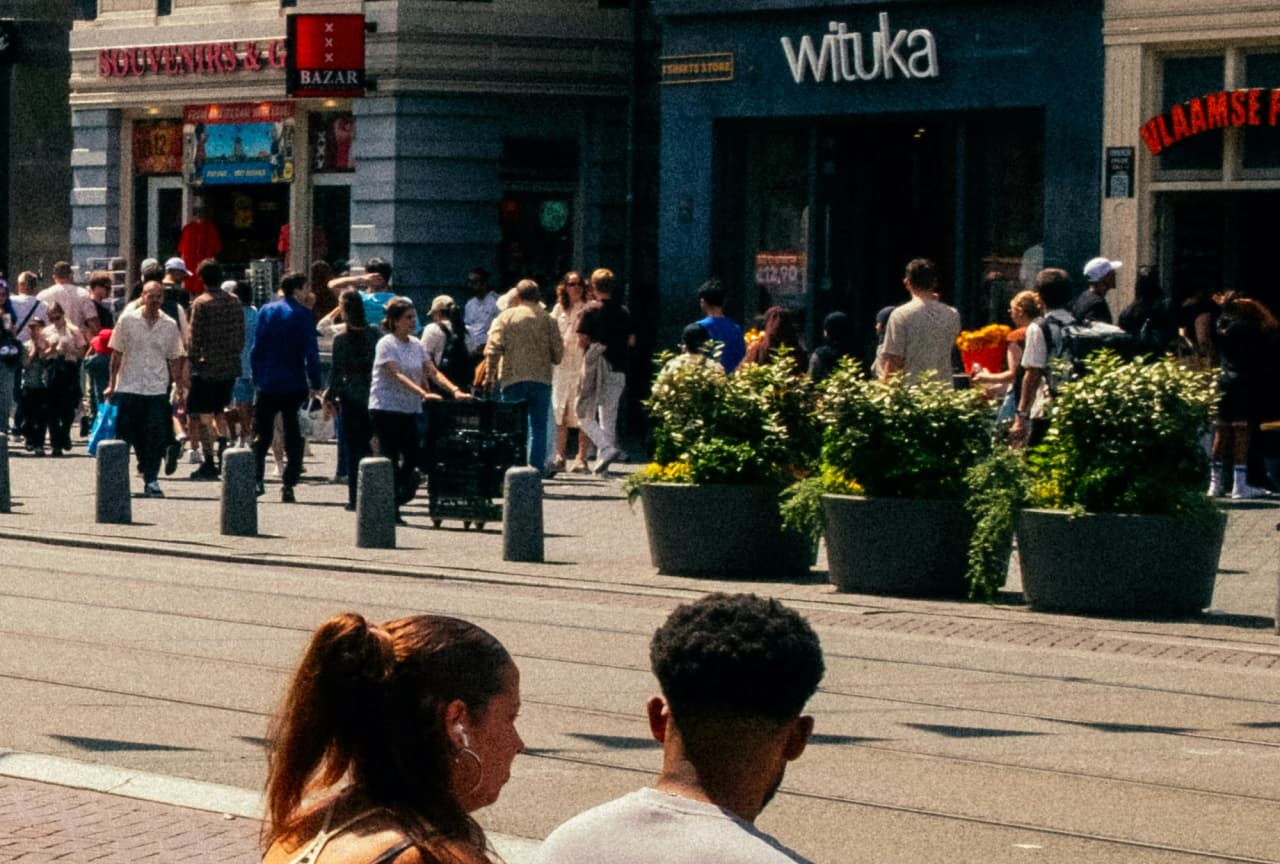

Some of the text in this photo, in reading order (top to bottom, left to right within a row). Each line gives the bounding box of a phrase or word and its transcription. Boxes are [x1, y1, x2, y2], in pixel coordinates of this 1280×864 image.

[99, 42, 237, 78] SOUVENIRS
[243, 40, 262, 71] &
[780, 12, 939, 84] wituka
[300, 70, 358, 85] BAZAR
[1139, 89, 1260, 156] VLAAMSE
